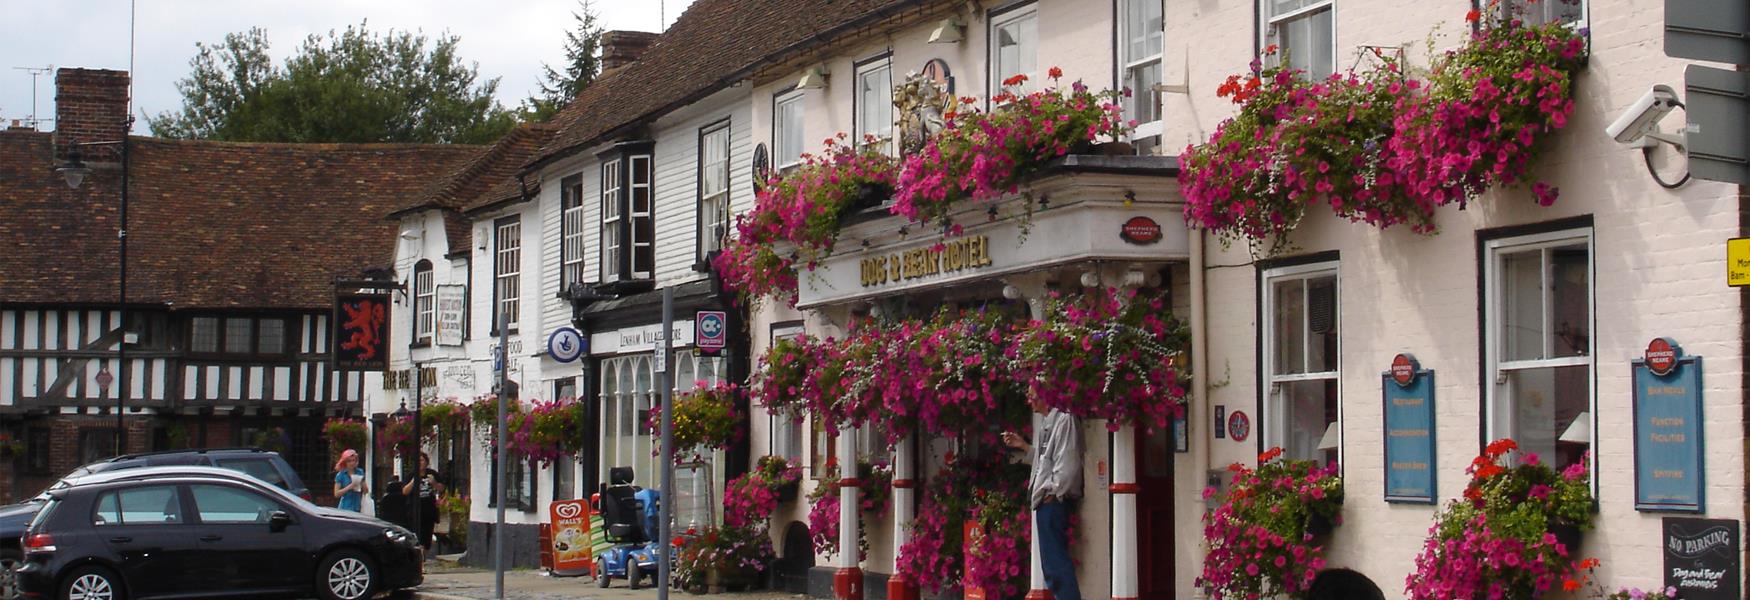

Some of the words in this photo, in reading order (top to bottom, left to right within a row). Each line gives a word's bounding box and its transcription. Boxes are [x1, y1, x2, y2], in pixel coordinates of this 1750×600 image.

[860, 255, 888, 287] DOG
[889, 253, 901, 282] &
[902, 247, 941, 280] BEAR
[942, 235, 992, 273] HOTEL
[382, 370, 397, 390] THE
[399, 369, 410, 389] RE
[1668, 536, 1682, 552] NO
[1685, 531, 1729, 552] PARKING
[1672, 567, 1689, 580] Dog
[1689, 568, 1704, 578] and
